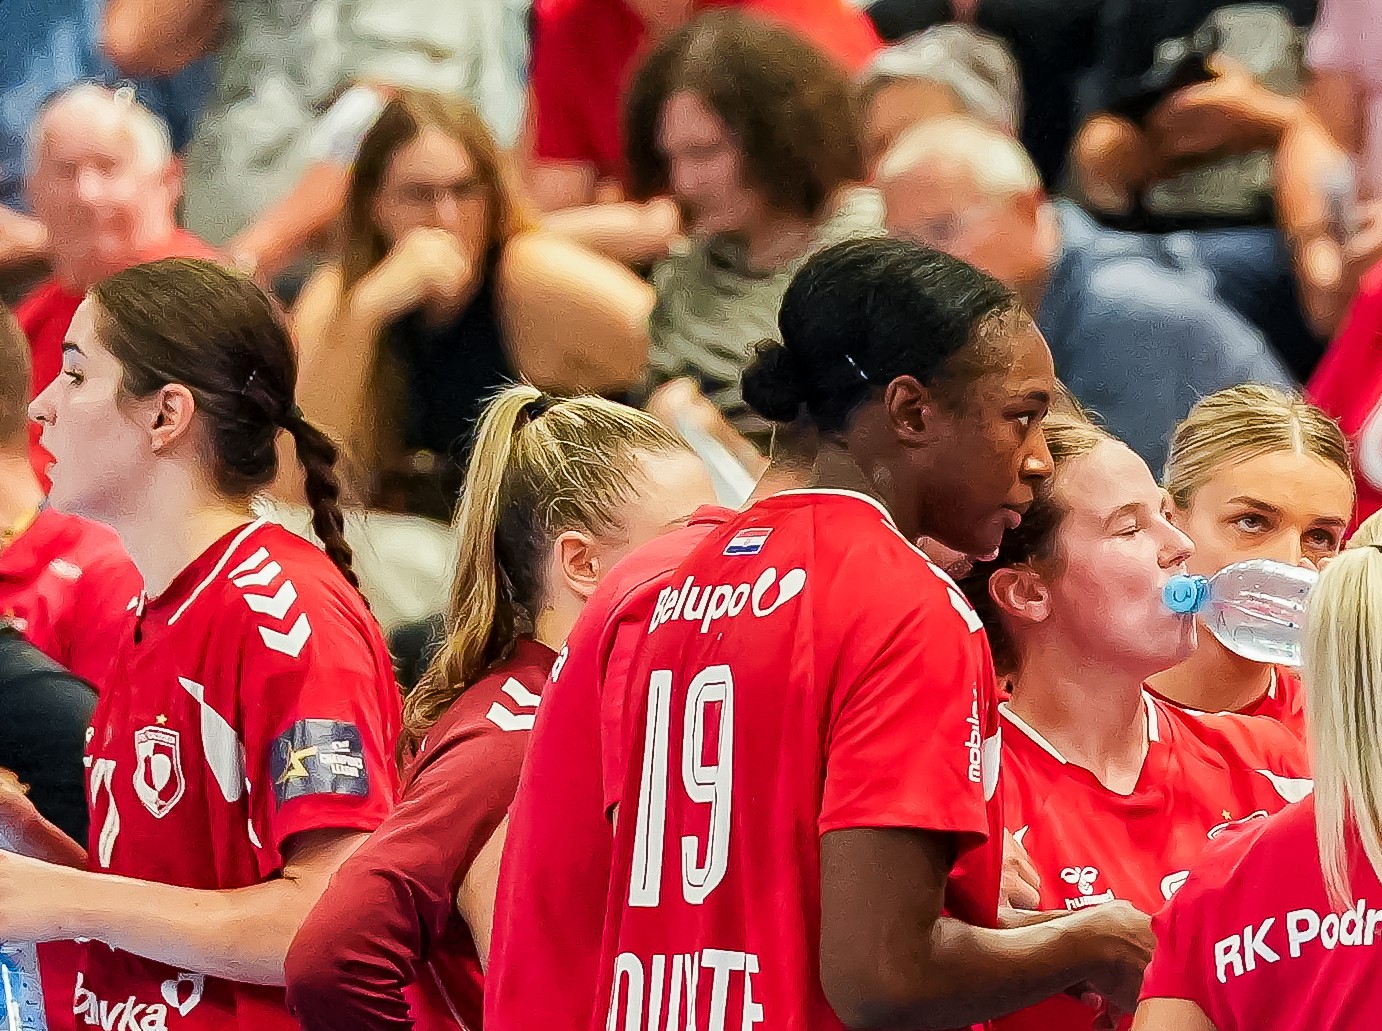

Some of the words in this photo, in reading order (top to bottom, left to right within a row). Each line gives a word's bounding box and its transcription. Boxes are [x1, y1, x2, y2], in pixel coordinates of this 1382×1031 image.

[648, 576, 750, 634] Belupo
[628, 665, 734, 906] 19
[1214, 917, 1280, 983] RK
